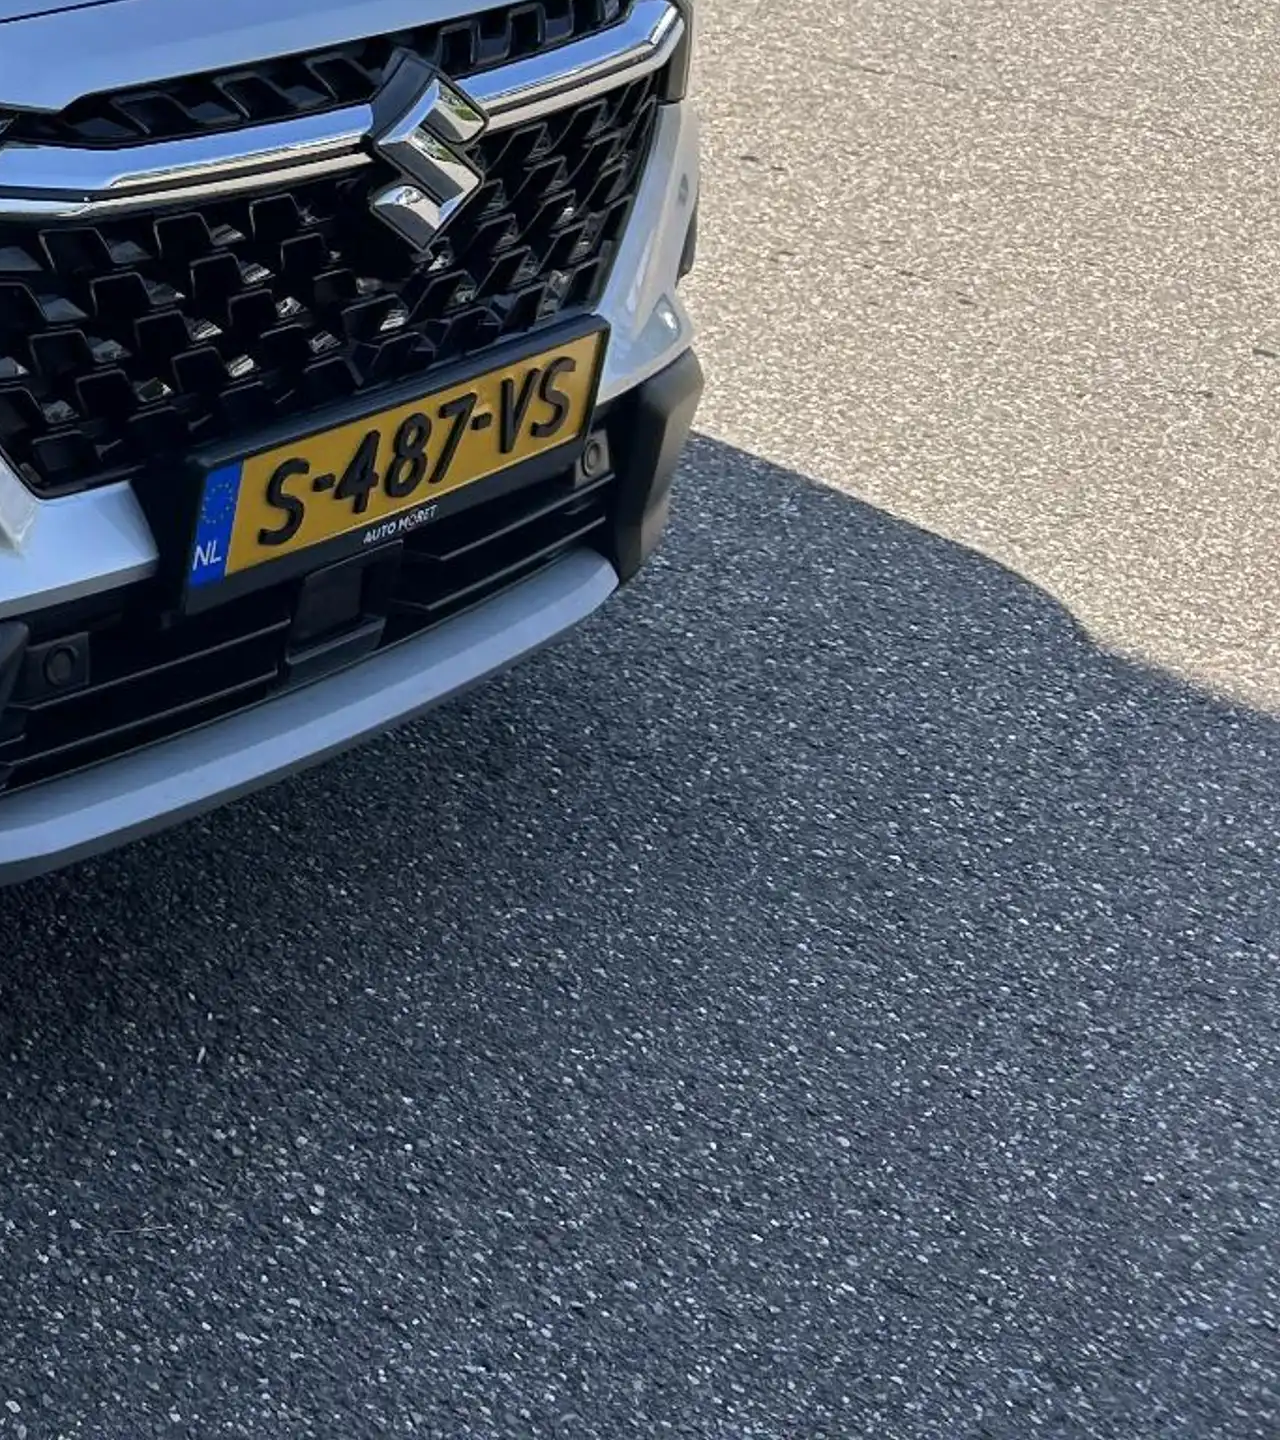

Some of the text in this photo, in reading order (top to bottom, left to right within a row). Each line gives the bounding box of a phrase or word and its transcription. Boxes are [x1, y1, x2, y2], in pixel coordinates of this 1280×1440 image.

[257, 356, 577, 547] S-487-VS
[363, 522, 396, 545] AUTO
[192, 540, 222, 571] NL
